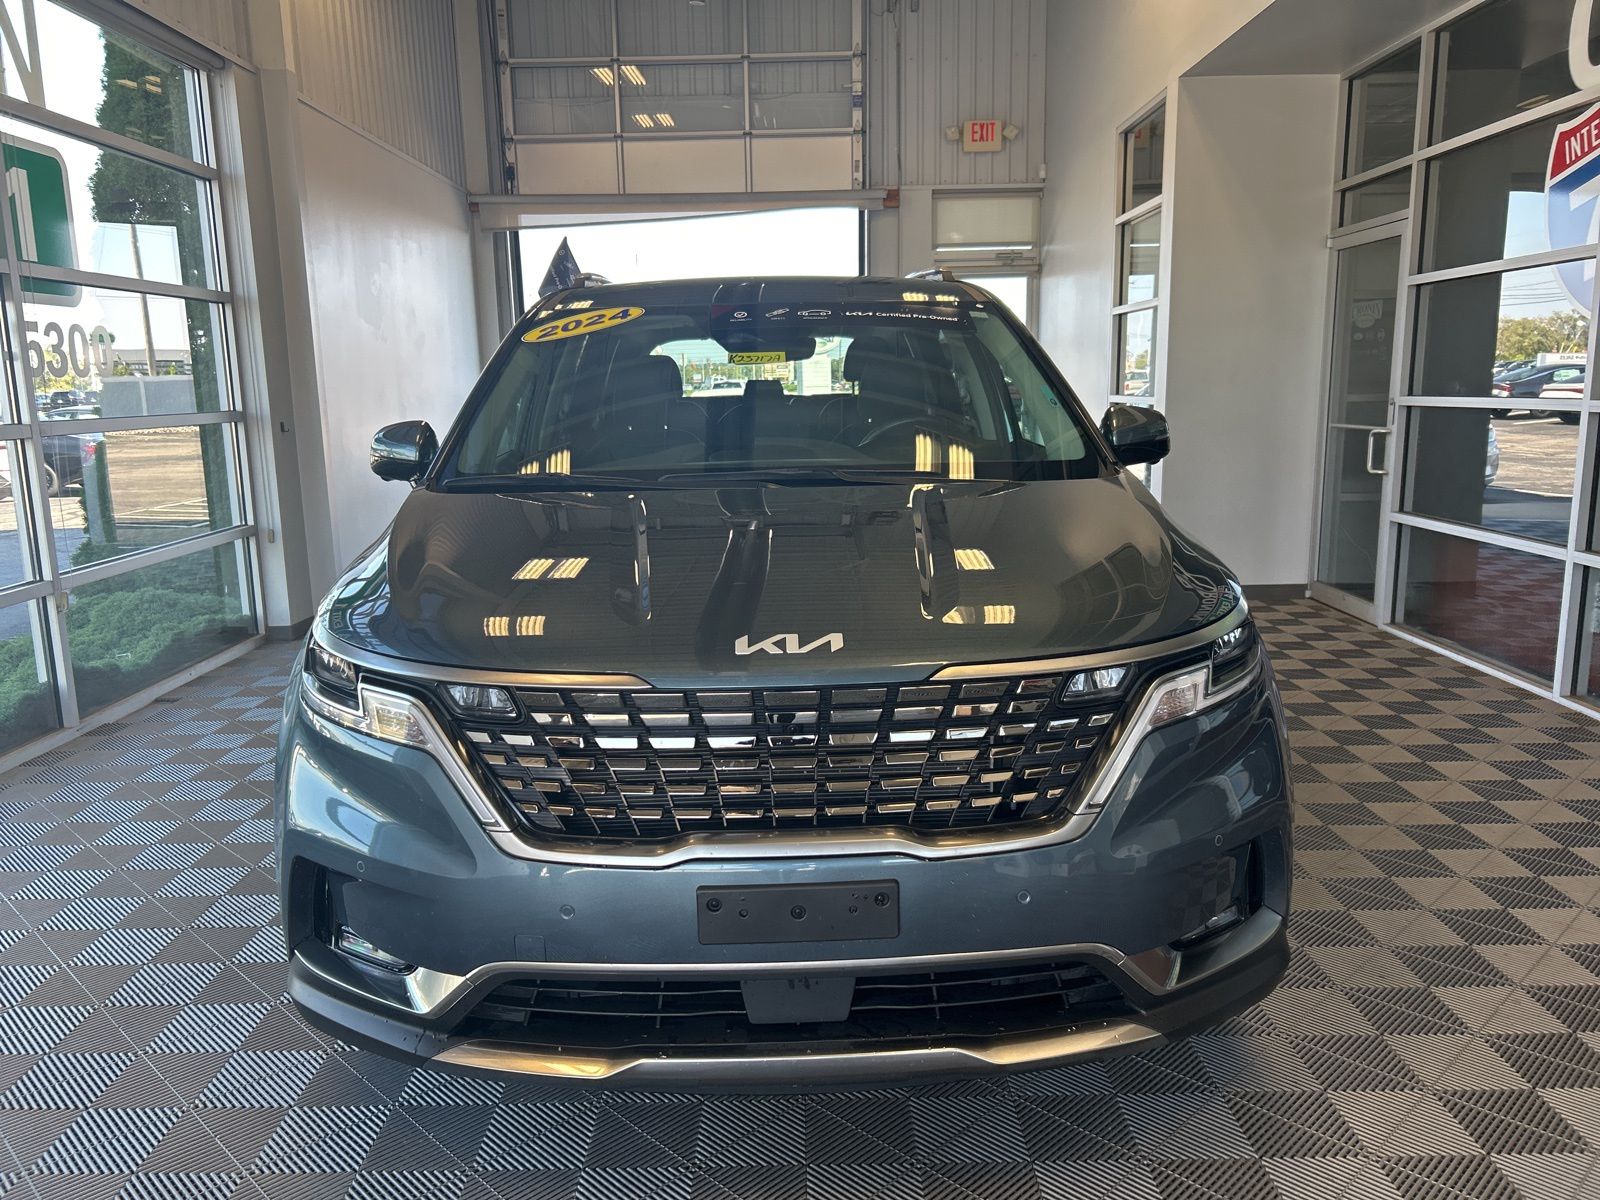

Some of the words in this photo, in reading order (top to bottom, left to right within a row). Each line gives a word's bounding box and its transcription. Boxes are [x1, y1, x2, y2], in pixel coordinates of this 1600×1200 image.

[971, 122, 996, 142] EXIT
[536, 308, 631, 340] 2024
[875, 311, 912, 319] Certified
[912, 313, 959, 322] Pre-Owned
[24, 321, 113, 379] 5300
[735, 633, 844, 655] KIA
